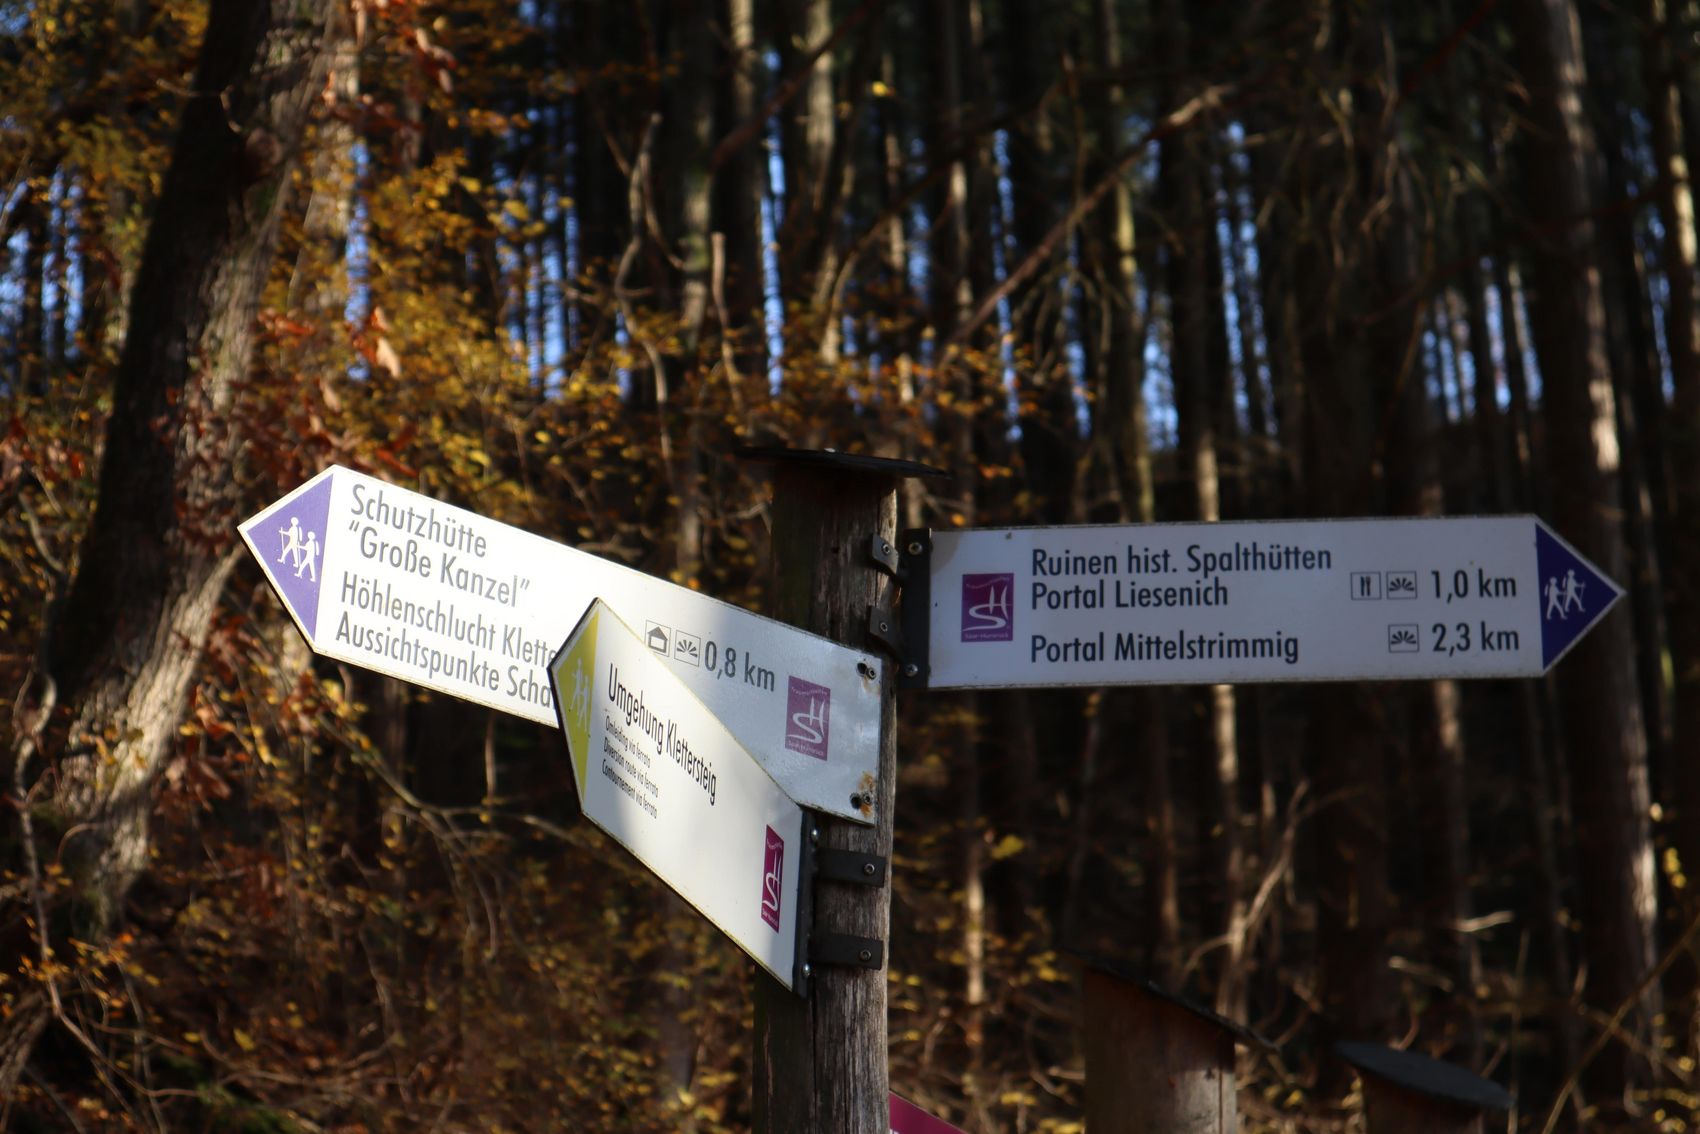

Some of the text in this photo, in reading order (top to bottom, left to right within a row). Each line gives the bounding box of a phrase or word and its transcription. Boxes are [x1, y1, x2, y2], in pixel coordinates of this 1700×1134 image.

[351, 483, 487, 558] Schutzhütte
[440, 552, 530, 607] Kanzel"
[1032, 542, 1332, 578] Ruinen hist. Spalthütten
[1032, 579, 1104, 610] Portal
[1115, 577, 1229, 608] Liesenich
[1431, 568, 1517, 604] 1,0 km
[341, 571, 496, 651] Höhlenschlucht
[336, 611, 553, 709] Aussichtspunkte Scha
[1031, 629, 1299, 665] Portal Mittelstrimmig
[1432, 621, 1519, 657] 2,3 km
[704, 640, 775, 692] 0,8 km
[608, 662, 717, 806] Umgehung Klettersteig
[628, 738, 636, 755] via
[603, 736, 625, 767] Diversion
[625, 760, 637, 778] route
[602, 758, 636, 801] Contournement
